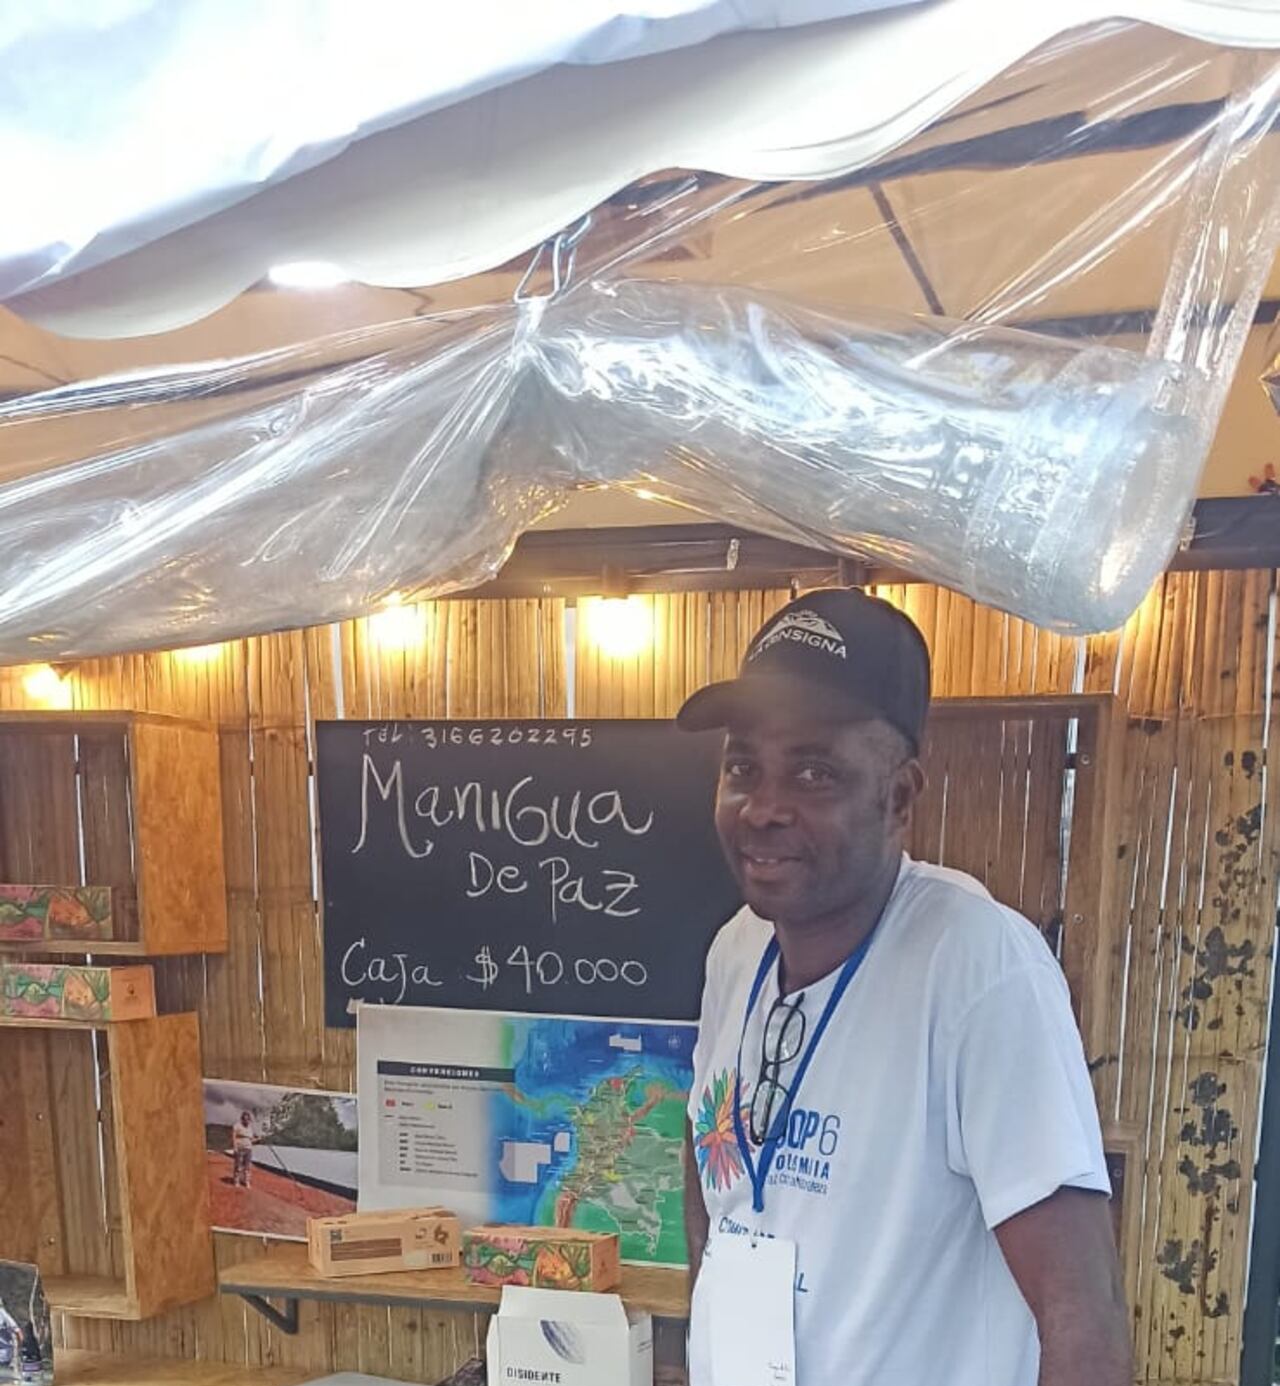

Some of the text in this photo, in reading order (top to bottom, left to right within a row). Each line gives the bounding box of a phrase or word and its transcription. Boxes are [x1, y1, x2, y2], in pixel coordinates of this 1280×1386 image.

[420, 726, 593, 749] 3166202295
[466, 851, 642, 924] De Paz
